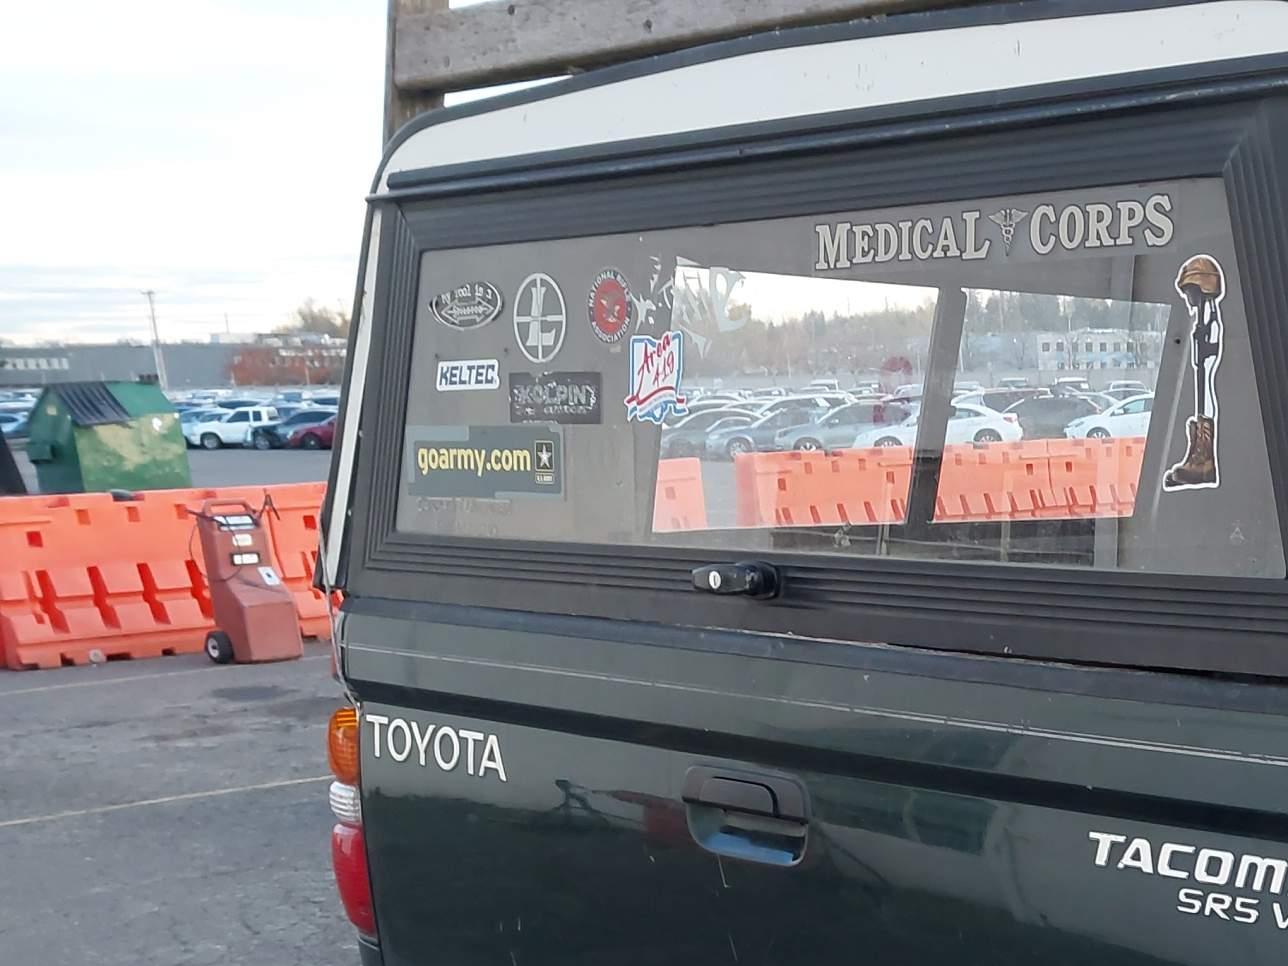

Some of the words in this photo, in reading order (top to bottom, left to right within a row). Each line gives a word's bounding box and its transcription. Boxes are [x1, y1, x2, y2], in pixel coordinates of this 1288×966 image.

[814, 210, 992, 271] MEDICAL
[1029, 193, 1175, 256] CORPS
[439, 363, 497, 386] KELTEC
[418, 446, 532, 478] goarmy.com
[365, 713, 508, 782] TOYOTA
[1177, 887, 1260, 924] SR5
